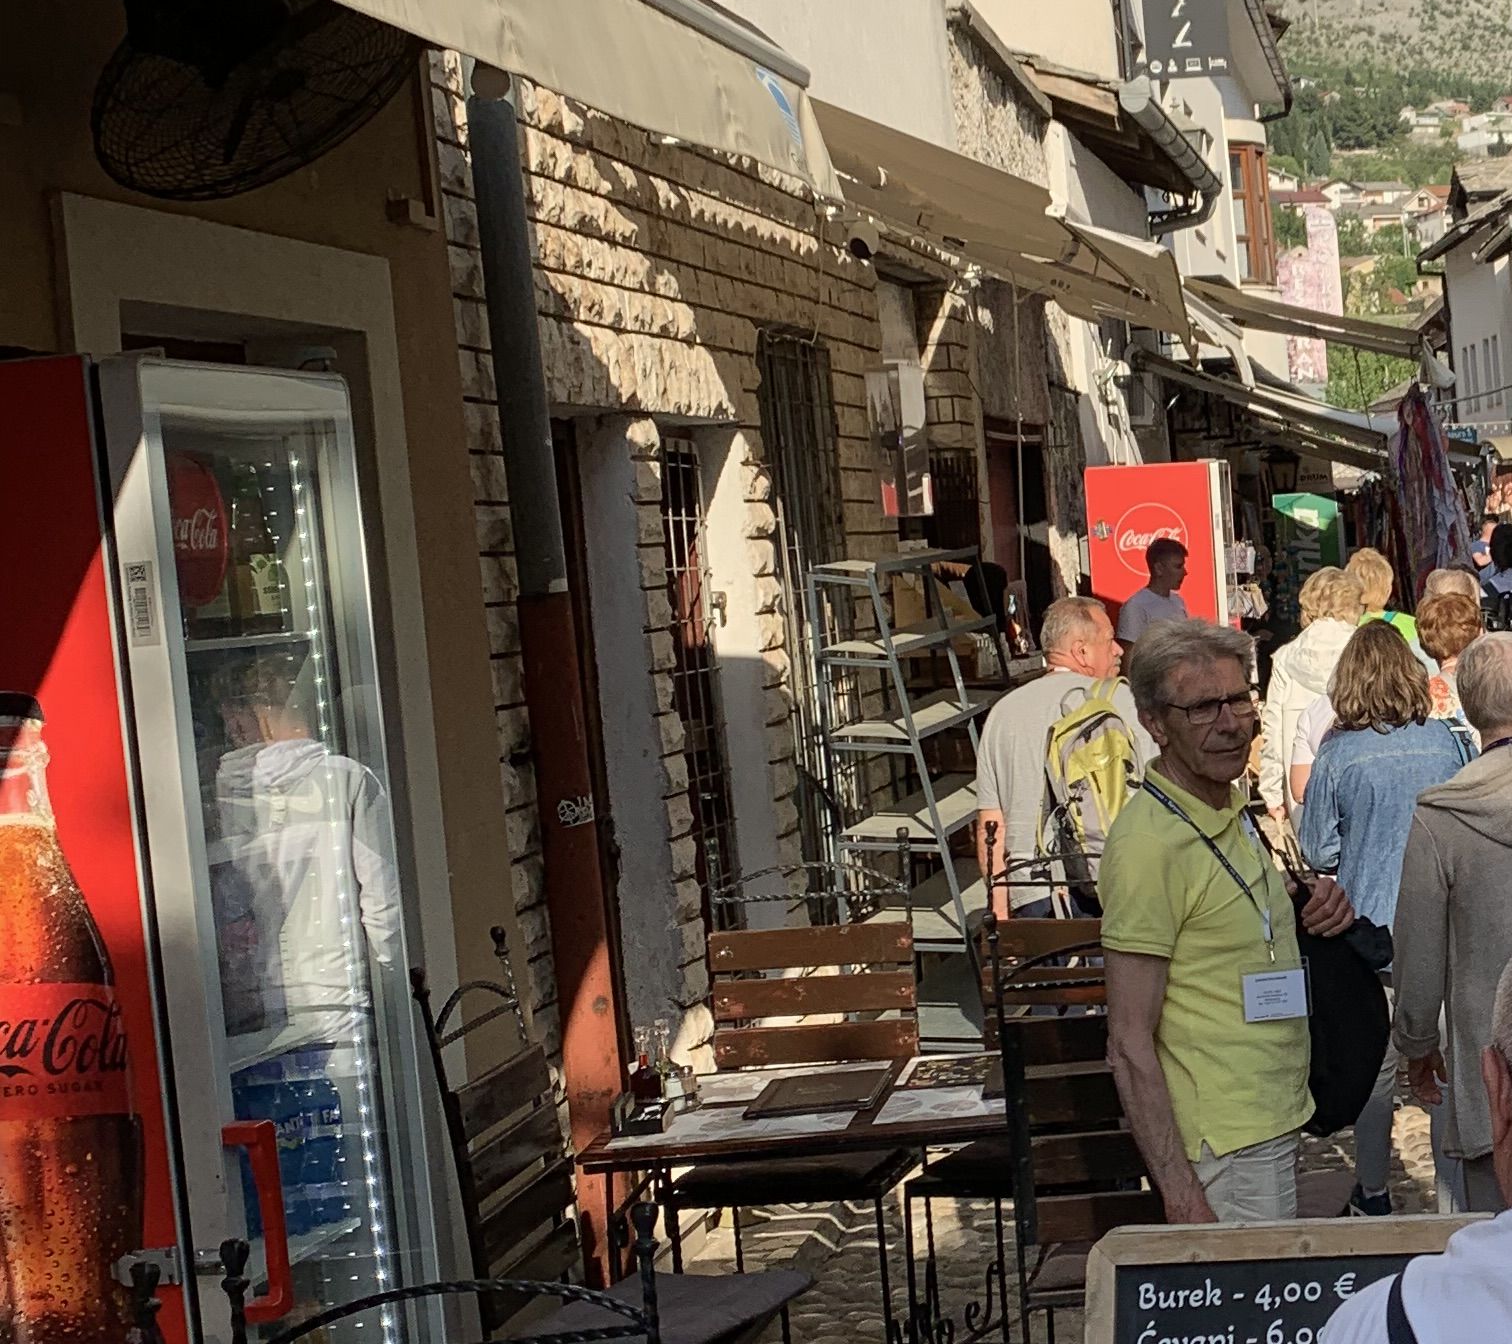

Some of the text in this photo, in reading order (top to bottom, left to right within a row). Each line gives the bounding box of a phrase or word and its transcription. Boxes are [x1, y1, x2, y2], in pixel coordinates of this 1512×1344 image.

[1138, 1272, 1357, 1311] Burek - 4,00 €
